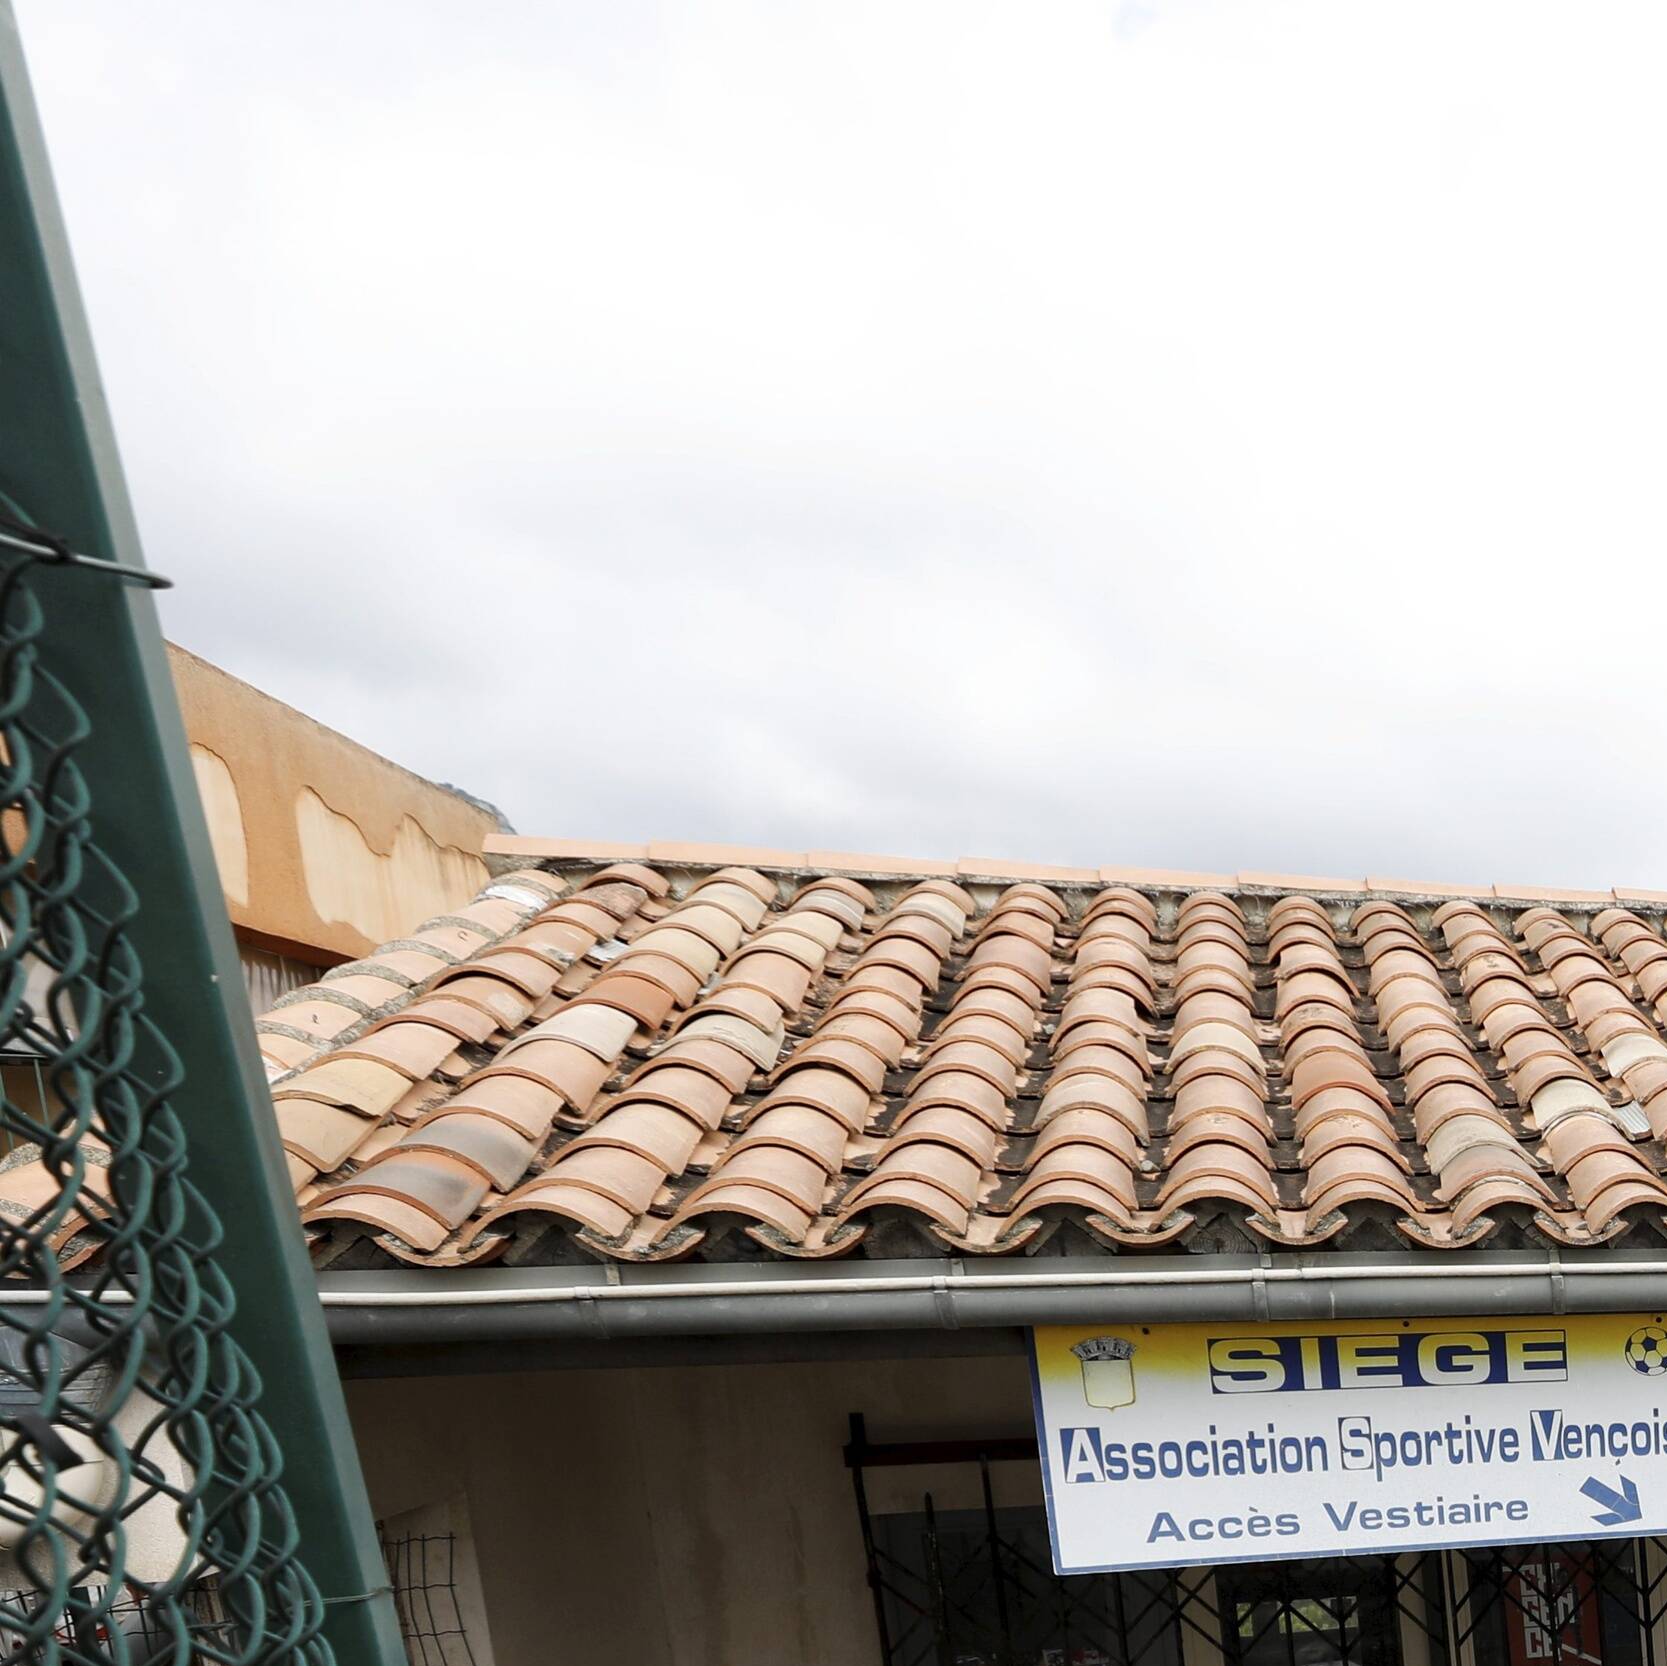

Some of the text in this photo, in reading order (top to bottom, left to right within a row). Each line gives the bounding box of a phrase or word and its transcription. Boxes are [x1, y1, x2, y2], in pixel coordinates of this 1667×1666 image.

[1208, 1330, 1568, 1394] SIEGE
[1060, 1424, 1328, 1483] Association
[1338, 1414, 1519, 1482] Sportive
[1147, 1495, 1529, 1543] Accès Vestiaire
